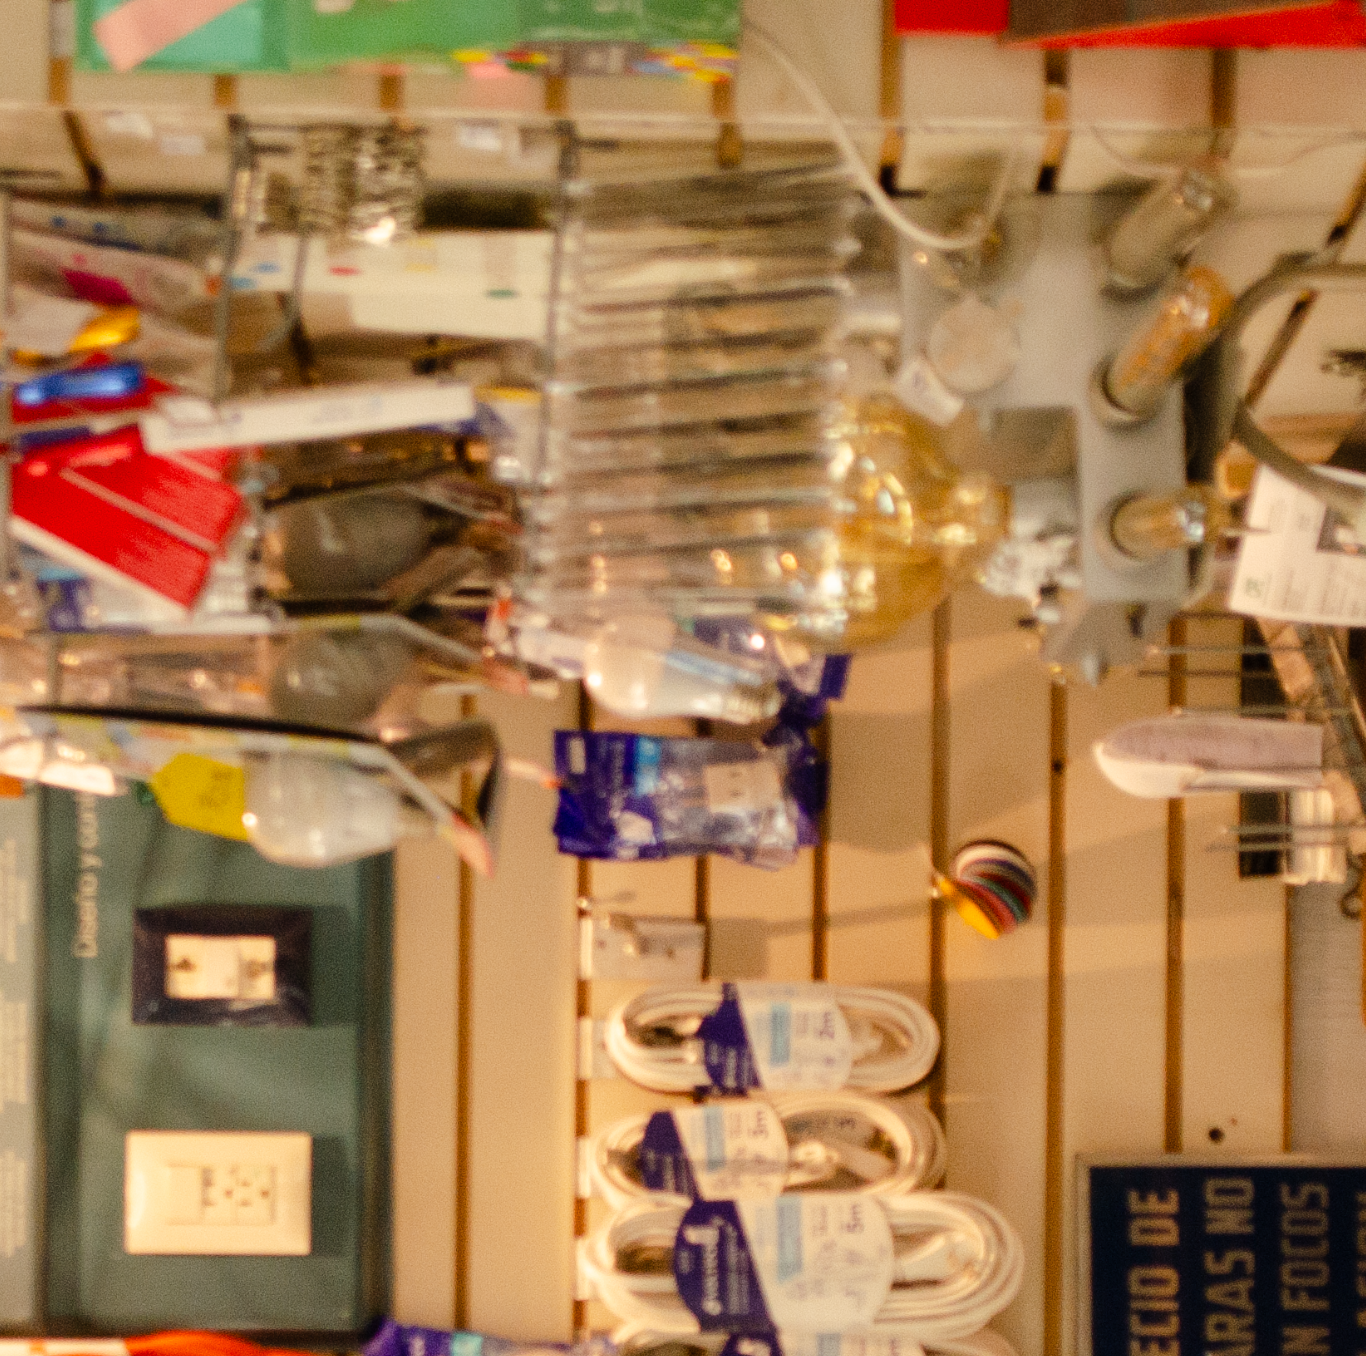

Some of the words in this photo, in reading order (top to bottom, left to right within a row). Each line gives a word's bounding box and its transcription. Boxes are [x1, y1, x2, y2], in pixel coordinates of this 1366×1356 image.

[78, 853, 103, 868] y
[846, 1204, 863, 1234] 5m
[1128, 1187, 1180, 1247] DE
[1203, 1177, 1255, 1236] NO
[1280, 1182, 1329, 1312] FOCOS
